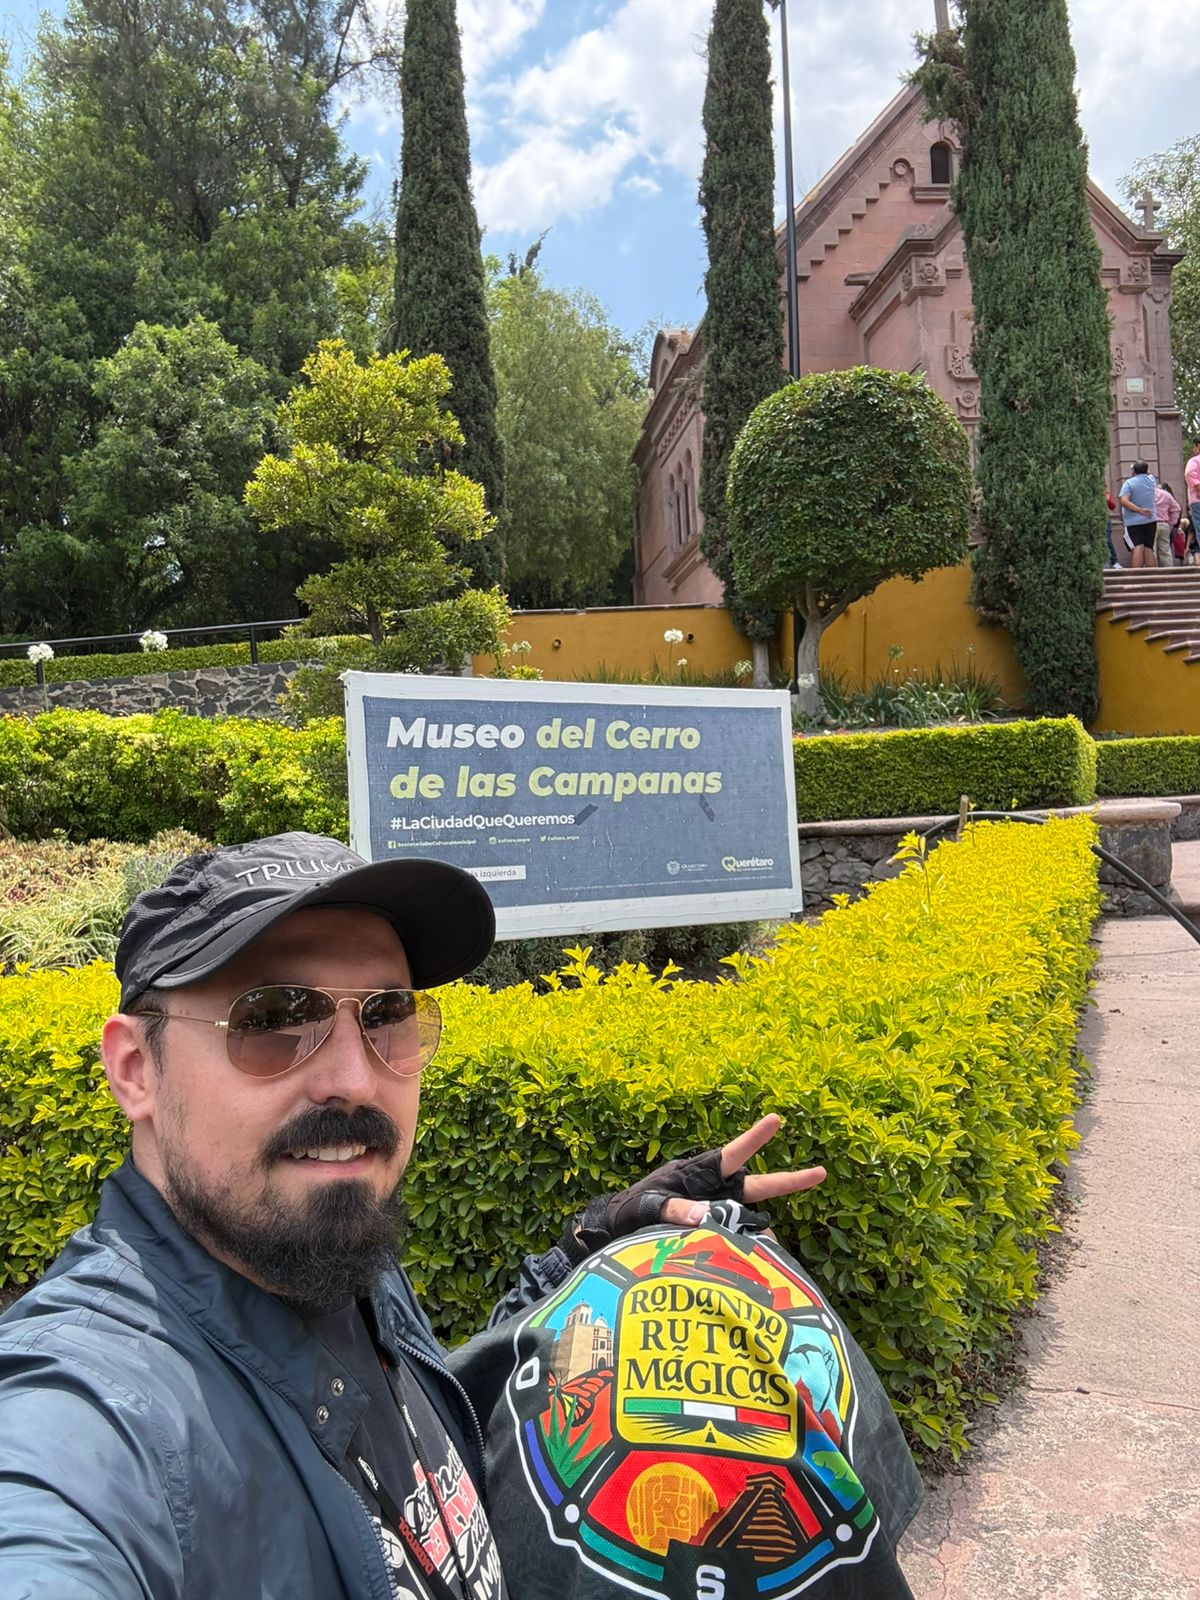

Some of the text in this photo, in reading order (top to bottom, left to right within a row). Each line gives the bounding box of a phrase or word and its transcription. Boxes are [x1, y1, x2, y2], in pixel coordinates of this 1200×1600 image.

[386, 716, 701, 750] Museo del Cerro
[390, 765, 722, 802] de las Campanas
[390, 814, 575, 831] #LaCiudadQueQueremos
[480, 868, 517, 879] izquierda
[721, 856, 774, 872] Querétaro
[696, 1564, 726, 1600] S
